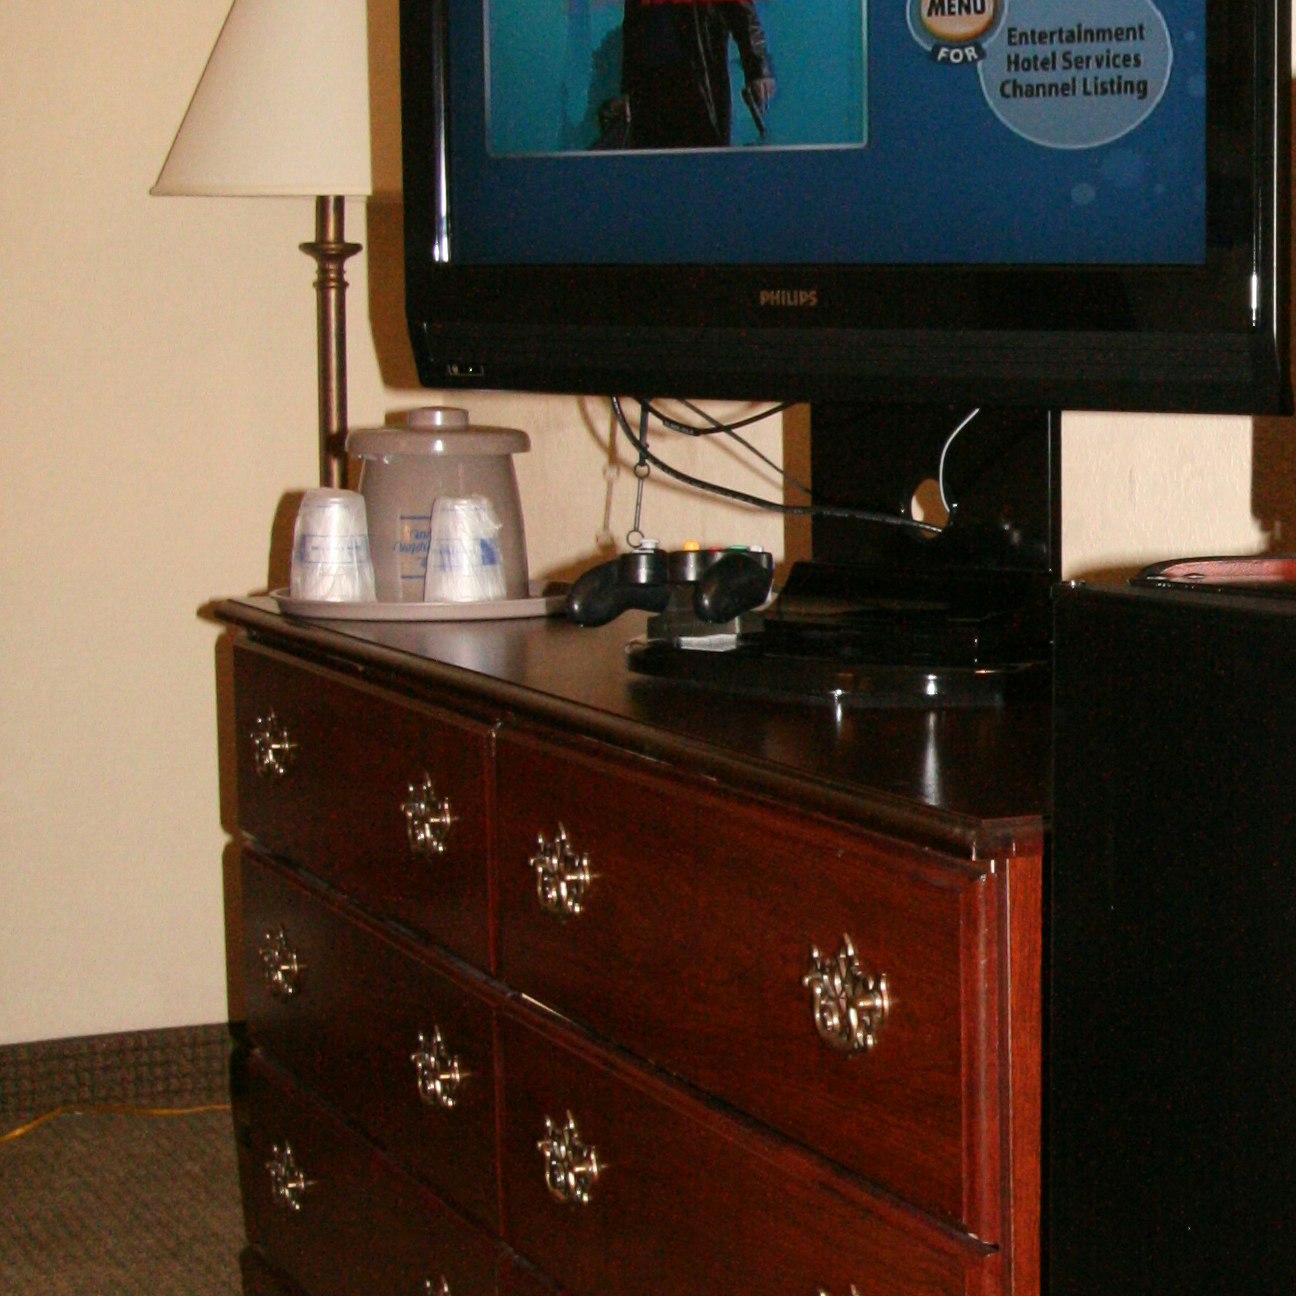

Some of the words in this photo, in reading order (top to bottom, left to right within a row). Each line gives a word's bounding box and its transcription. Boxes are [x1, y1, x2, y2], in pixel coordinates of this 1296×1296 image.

[1007, 23, 1145, 46] Entertainment
[937, 45, 979, 64] FOR
[1006, 50, 1057, 73] Hotel
[1061, 49, 1142, 71] Services
[999, 76, 1078, 99] Channel
[1083, 75, 1149, 101] Listing
[759, 289, 819, 307] PHILIPS
